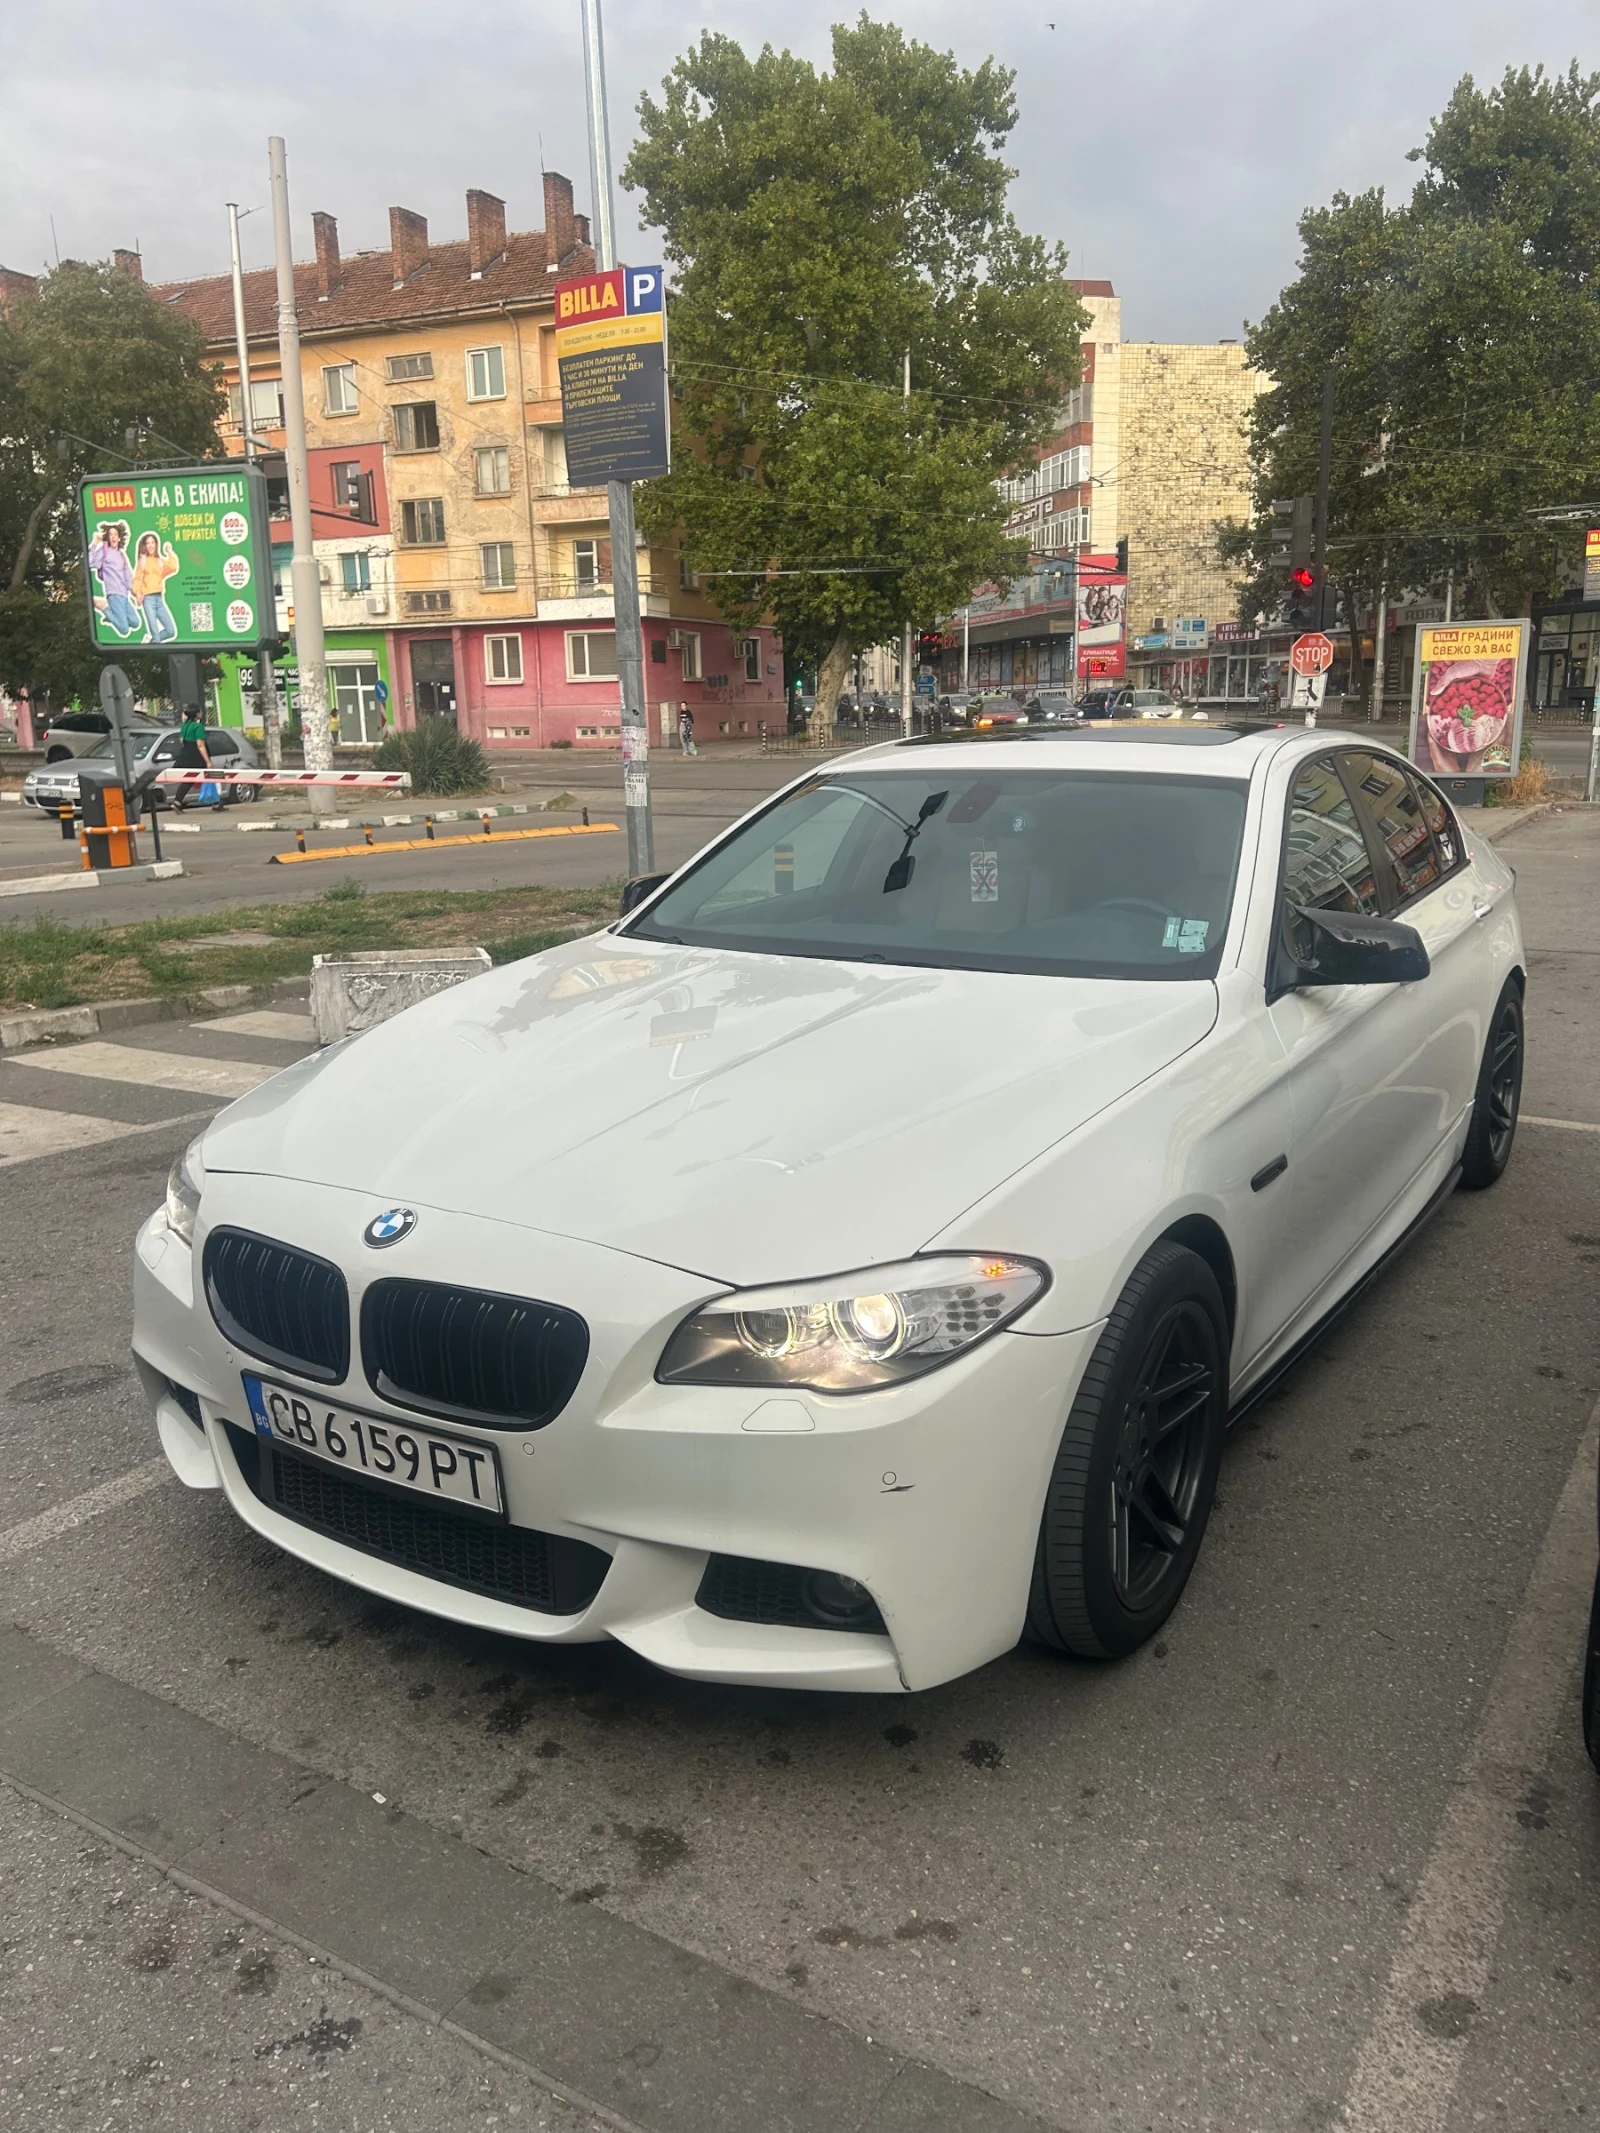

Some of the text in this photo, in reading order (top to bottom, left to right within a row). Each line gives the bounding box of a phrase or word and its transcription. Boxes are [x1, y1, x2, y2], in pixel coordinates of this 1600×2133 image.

[633, 274, 655, 307] P
[560, 282, 618, 318] BILLA
[596, 330, 615, 339] НЕДЕЛЯ
[562, 352, 636, 372] БЕЗПЛАТЕН ПАРКИНГ ДО
[567, 372, 578, 381] ЧАС
[578, 371, 583, 379] И
[591, 366, 616, 376] МИНУТИ
[617, 364, 628, 373] НА
[628, 361, 644, 372] ДЕН
[564, 373, 627, 391] ЗА КЛИЕНТИ НА BILLA
[565, 385, 614, 401] И ПРИЛЕЖАЩИТЕ
[565, 393, 621, 410] ТЪРГОВСКИ ПЛОЩИ
[95, 491, 133, 509] BILLA
[141, 481, 244, 508] ЕЛА В ЕКИПА!
[174, 512, 215, 528] ДОВЕДИ СИ
[224, 518, 239, 528] 800
[175, 530, 181, 541] И
[182, 527, 217, 541] ПРИЯТЕЛ!
[229, 563, 244, 572] 500
[231, 606, 246, 615] 200
[1434, 630, 1513, 642] BILLA ГРАДИНИ
[1295, 646, 1329, 663] STOP
[1433, 643, 1512, 655] СВЕЖО ЗА ВАС
[256, 1412, 269, 1429] BG
